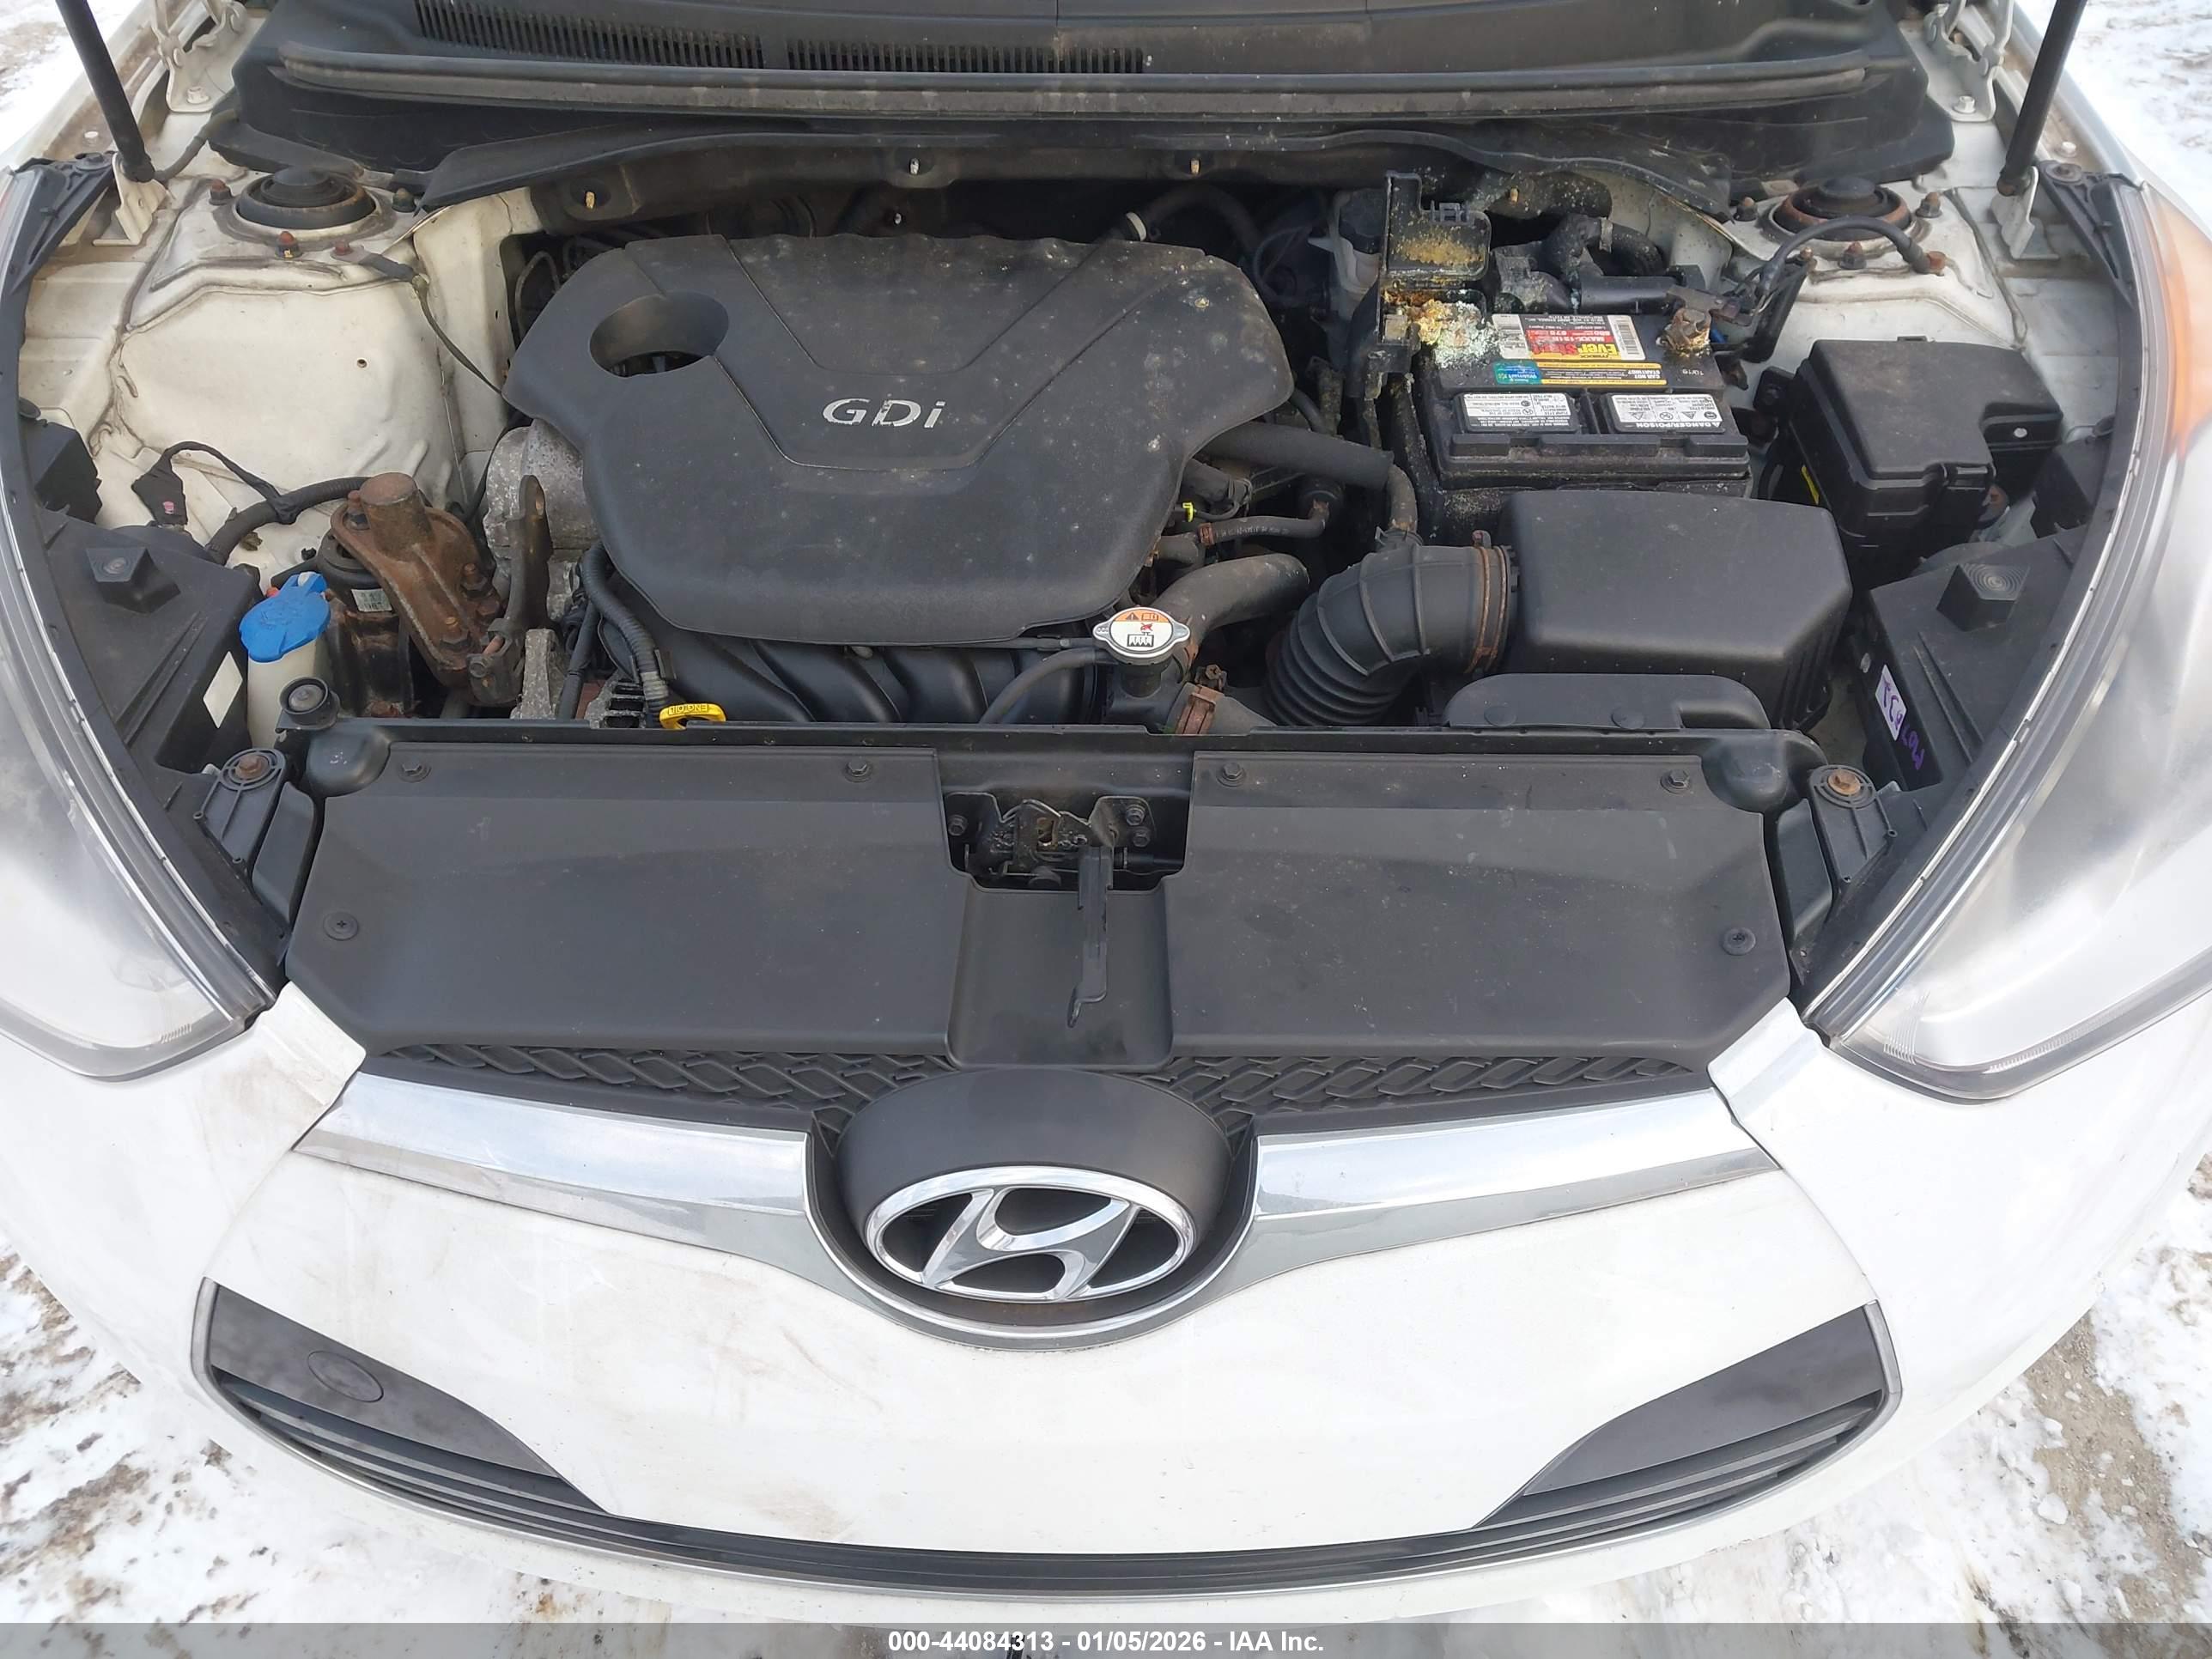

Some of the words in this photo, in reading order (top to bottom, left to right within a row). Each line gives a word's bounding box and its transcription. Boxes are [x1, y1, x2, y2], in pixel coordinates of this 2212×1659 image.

[1531, 342, 1619, 357] EverStart
[822, 398, 945, 428] GDi
[668, 705, 684, 715] OIL
